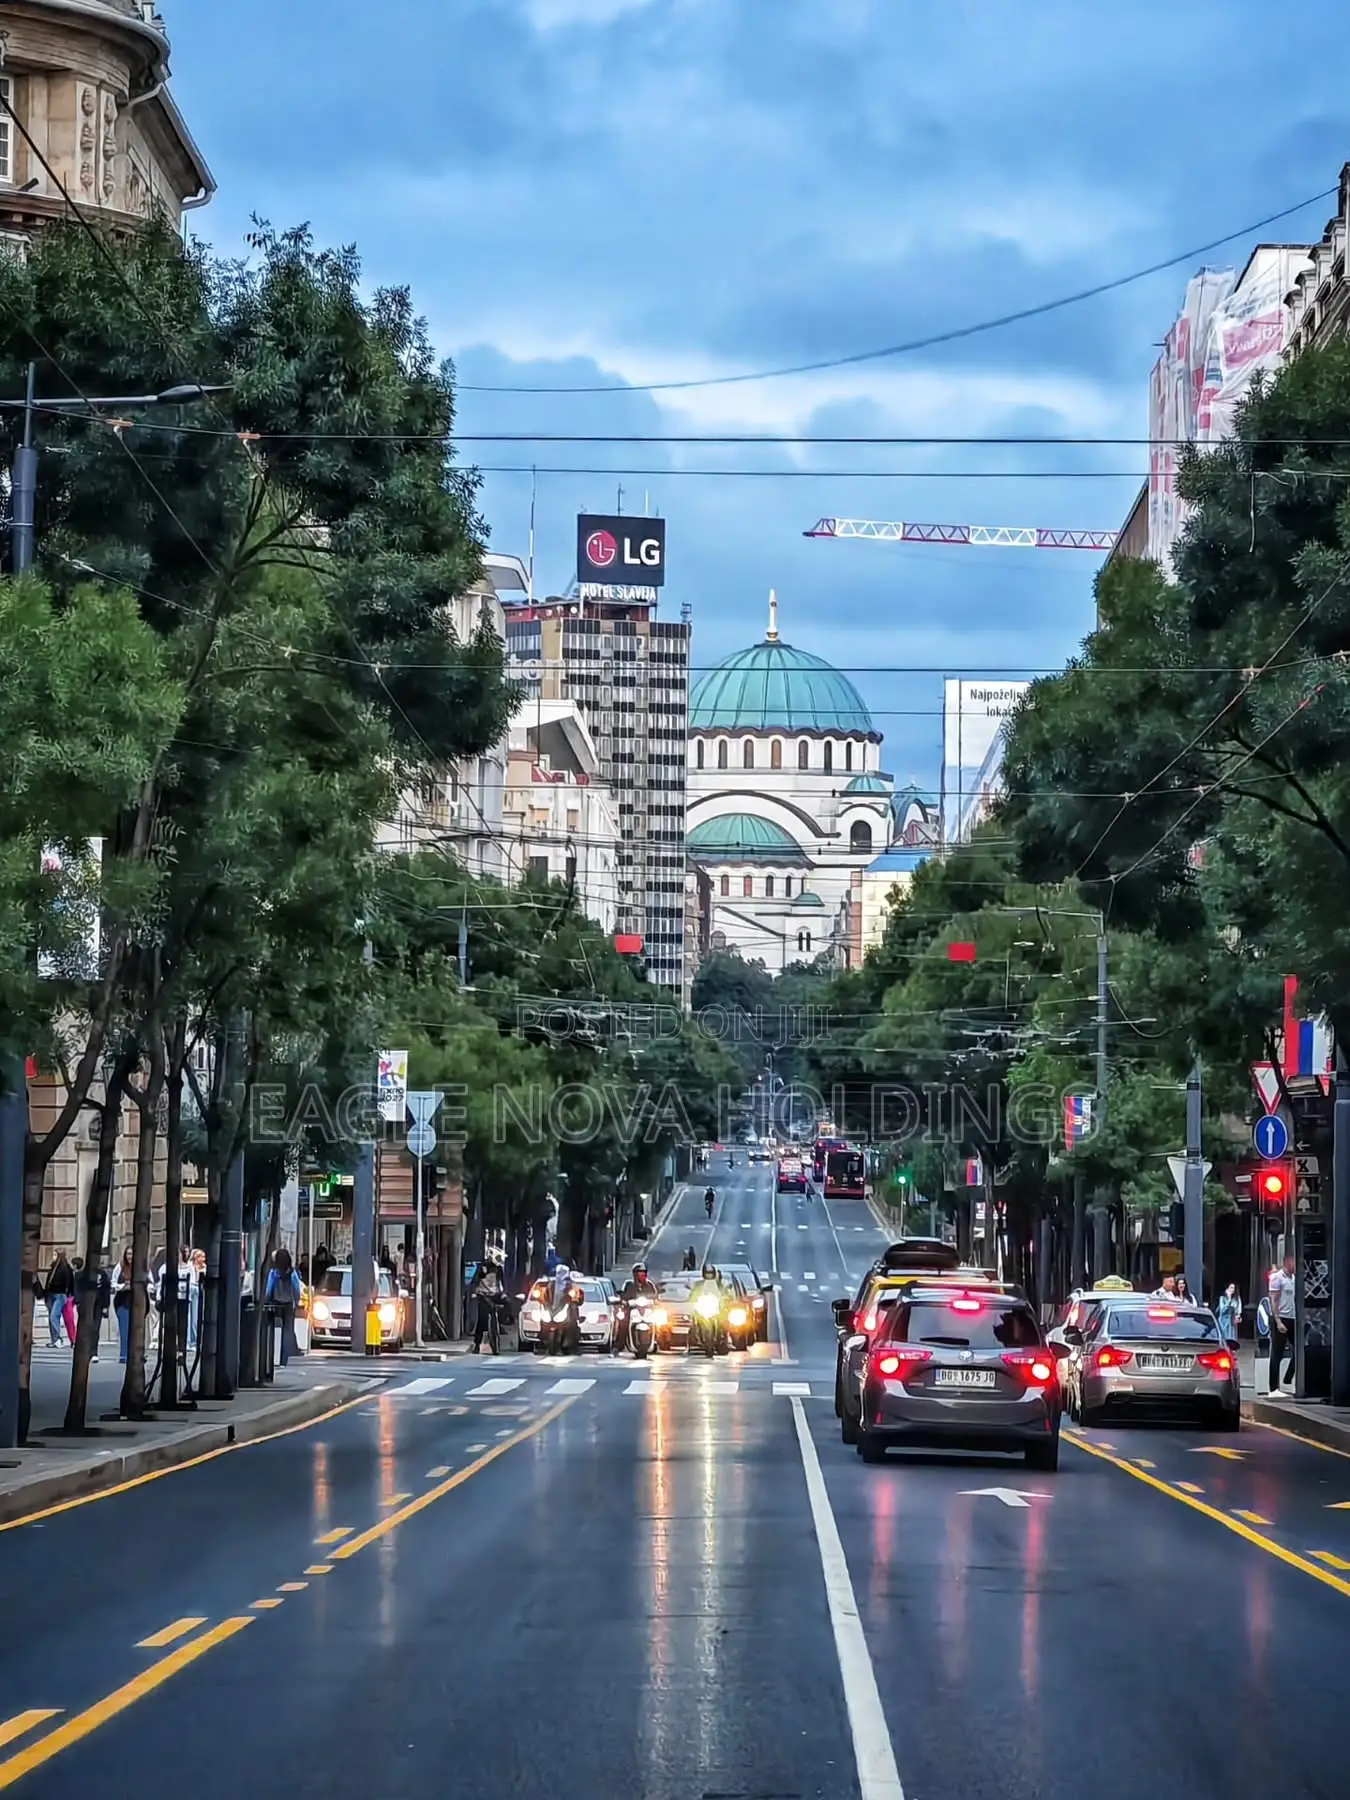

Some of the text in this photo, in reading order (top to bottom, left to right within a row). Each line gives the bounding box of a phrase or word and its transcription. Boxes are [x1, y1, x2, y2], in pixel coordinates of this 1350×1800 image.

[624, 537, 660, 566] LG
[583, 582, 657, 601] HOTEL SLAVIJA
